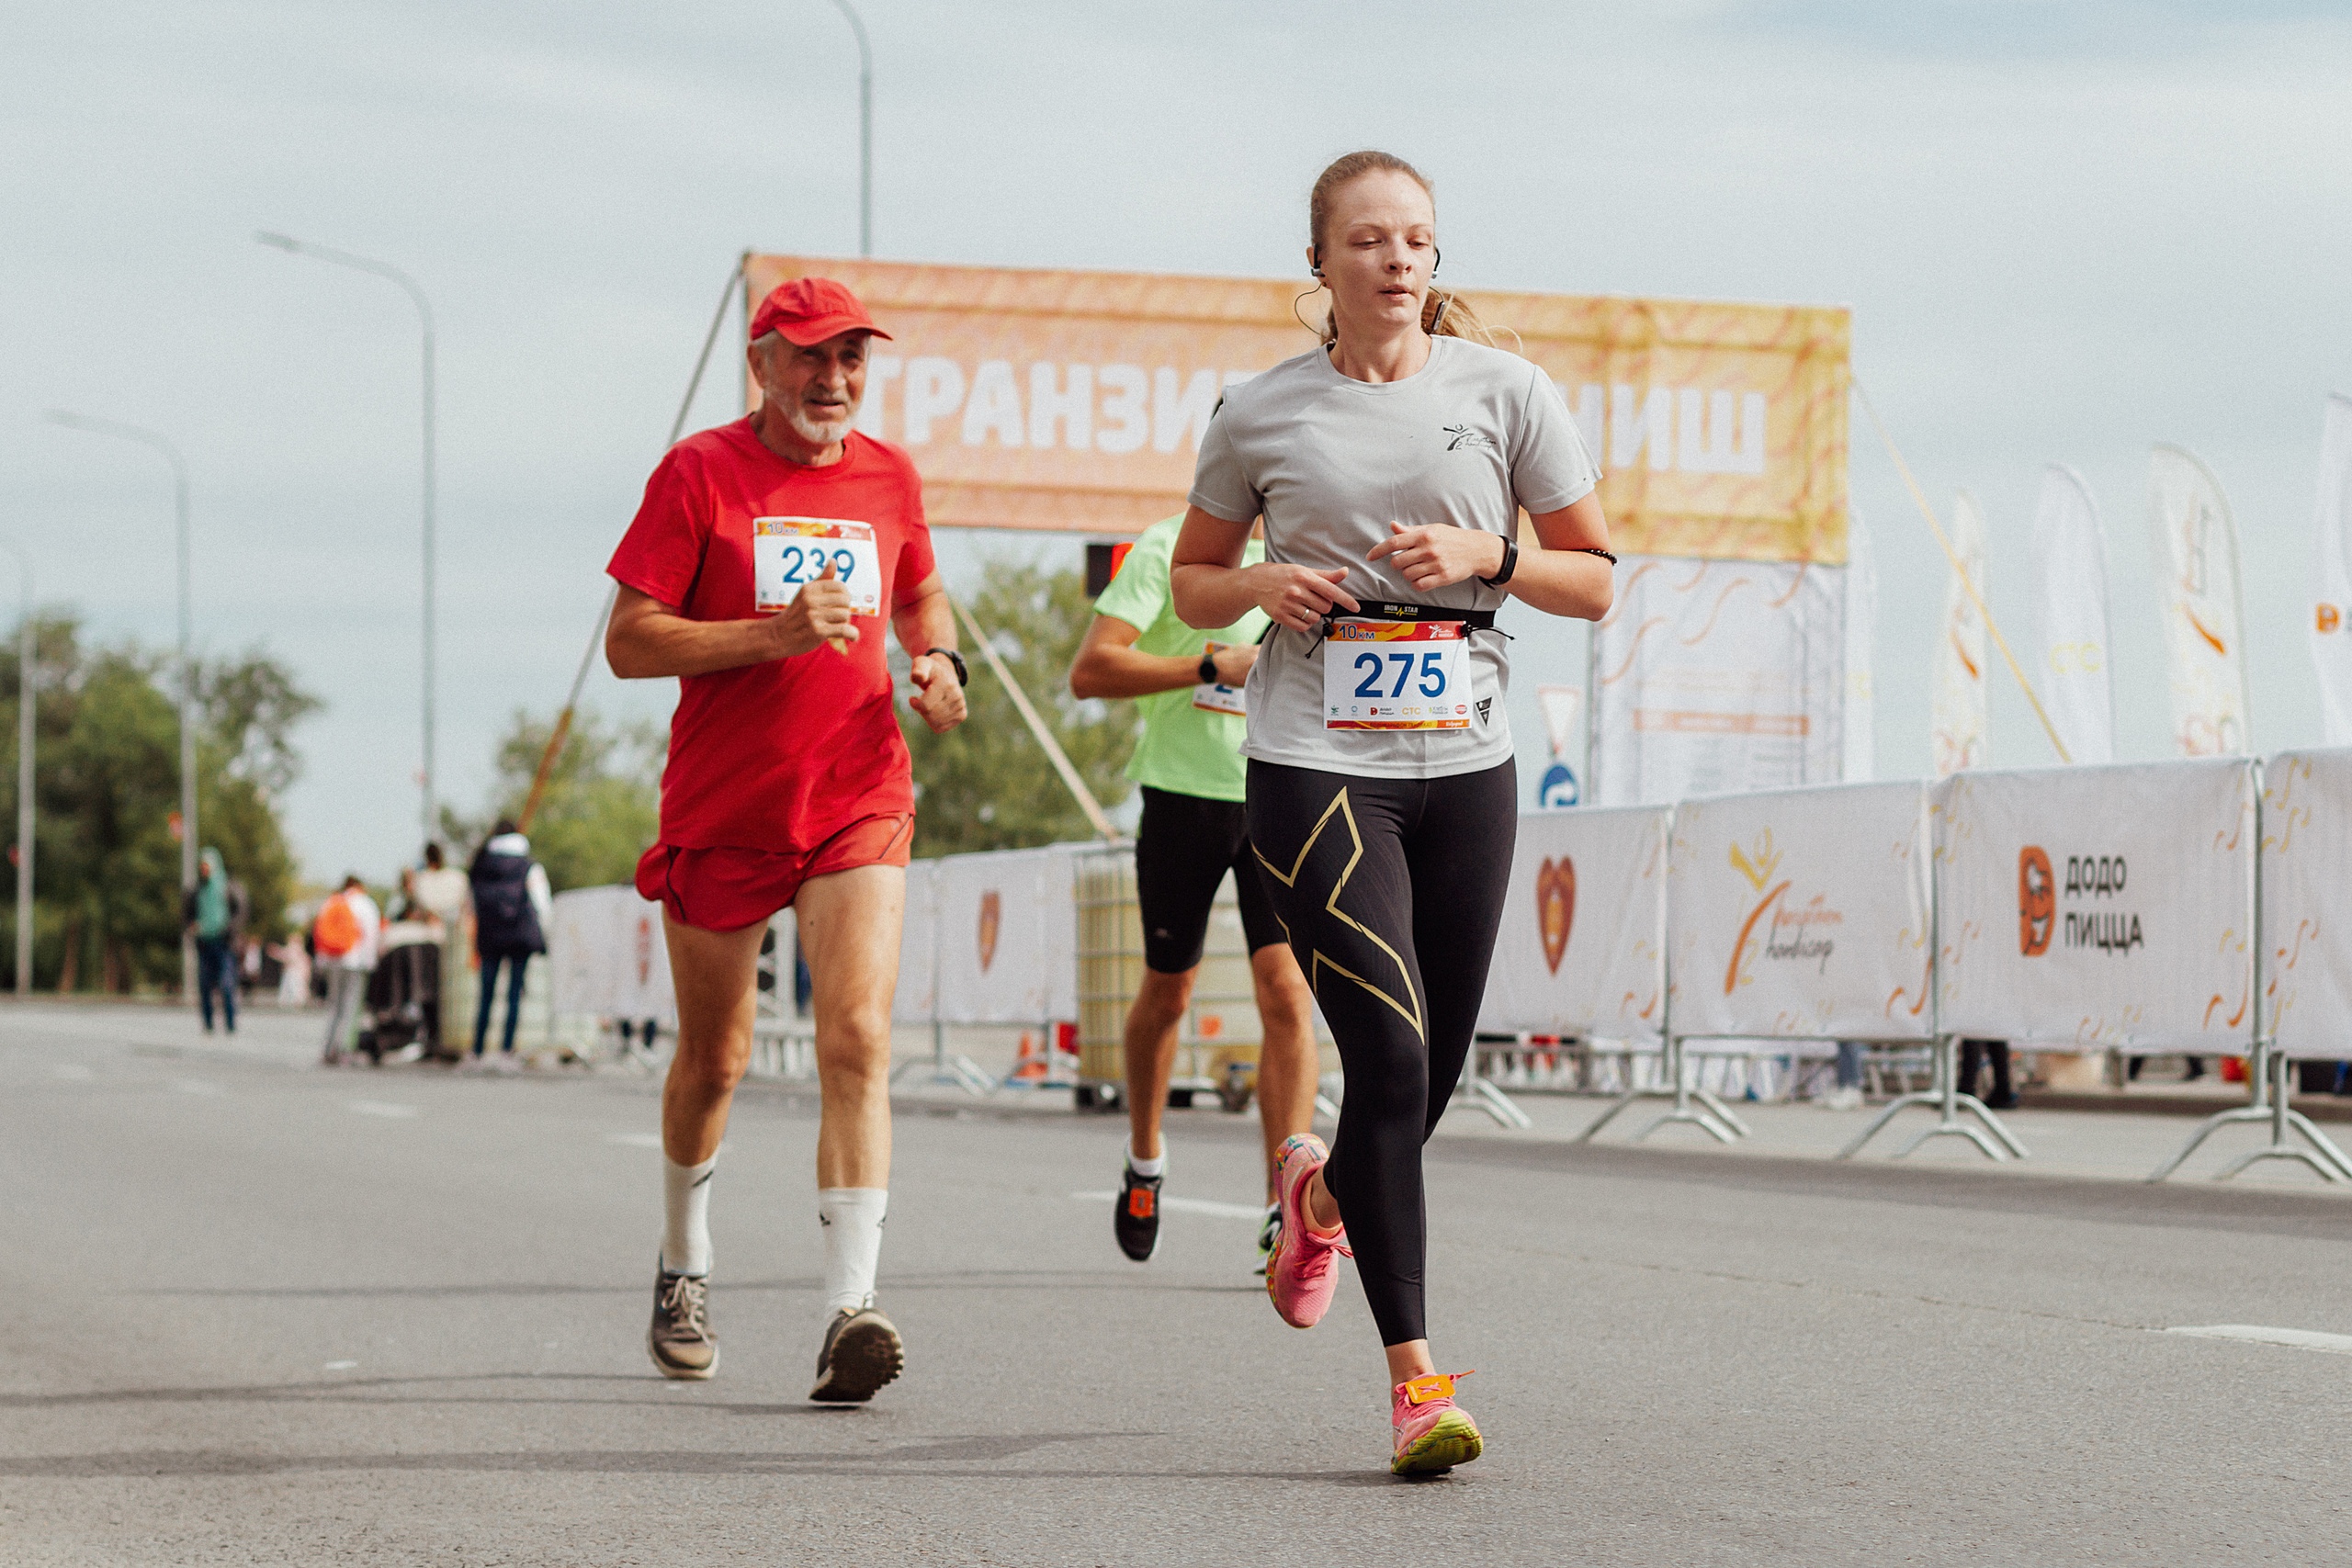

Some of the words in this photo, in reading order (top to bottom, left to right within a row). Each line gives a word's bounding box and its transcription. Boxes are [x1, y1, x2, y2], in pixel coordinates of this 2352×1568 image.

[859, 355, 1263, 455] ТРАНЗИ
[1554, 382, 1767, 477] НИШ
[781, 546, 855, 584] 239
[1404, 605, 1419, 614] STAR
[1353, 652, 1446, 698] 275
[2064, 855, 2128, 898] ДОДО
[2064, 912, 2145, 956] ПИЦЦА
